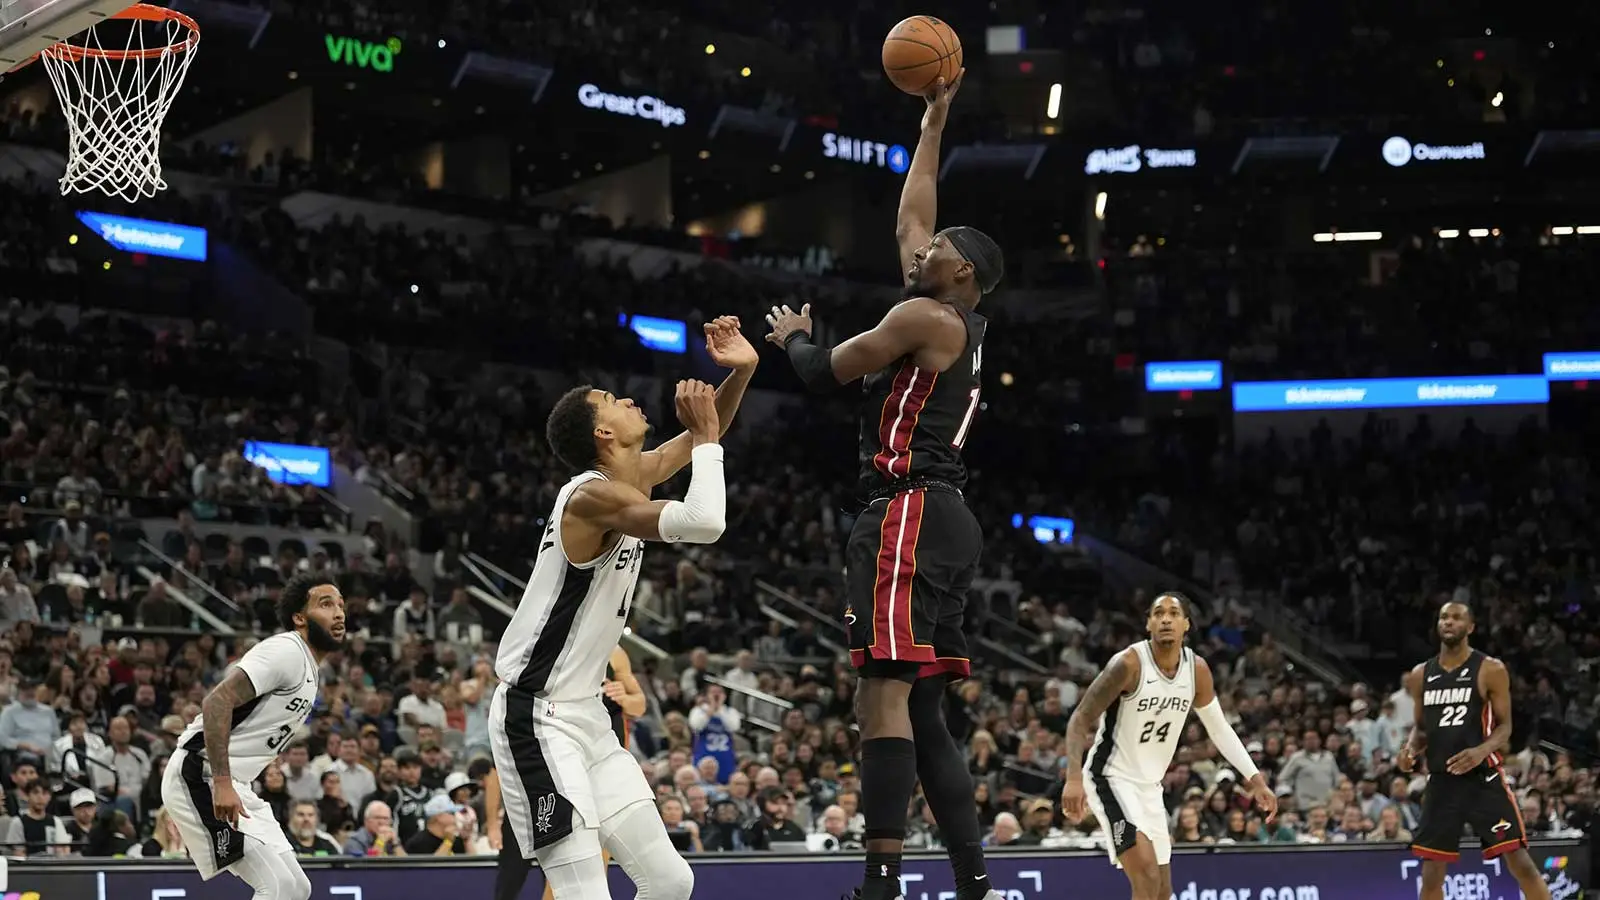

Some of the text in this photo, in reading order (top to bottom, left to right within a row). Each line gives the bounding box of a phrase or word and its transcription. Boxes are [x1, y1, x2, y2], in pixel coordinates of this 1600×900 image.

[578, 83, 686, 128] Great Clips
[1137, 696, 1190, 715] SPURS
[1423, 687, 1472, 706] MIAMI
[1439, 705, 1468, 727] 22
[705, 733, 731, 752] 32
[1139, 721, 1172, 744] 24
